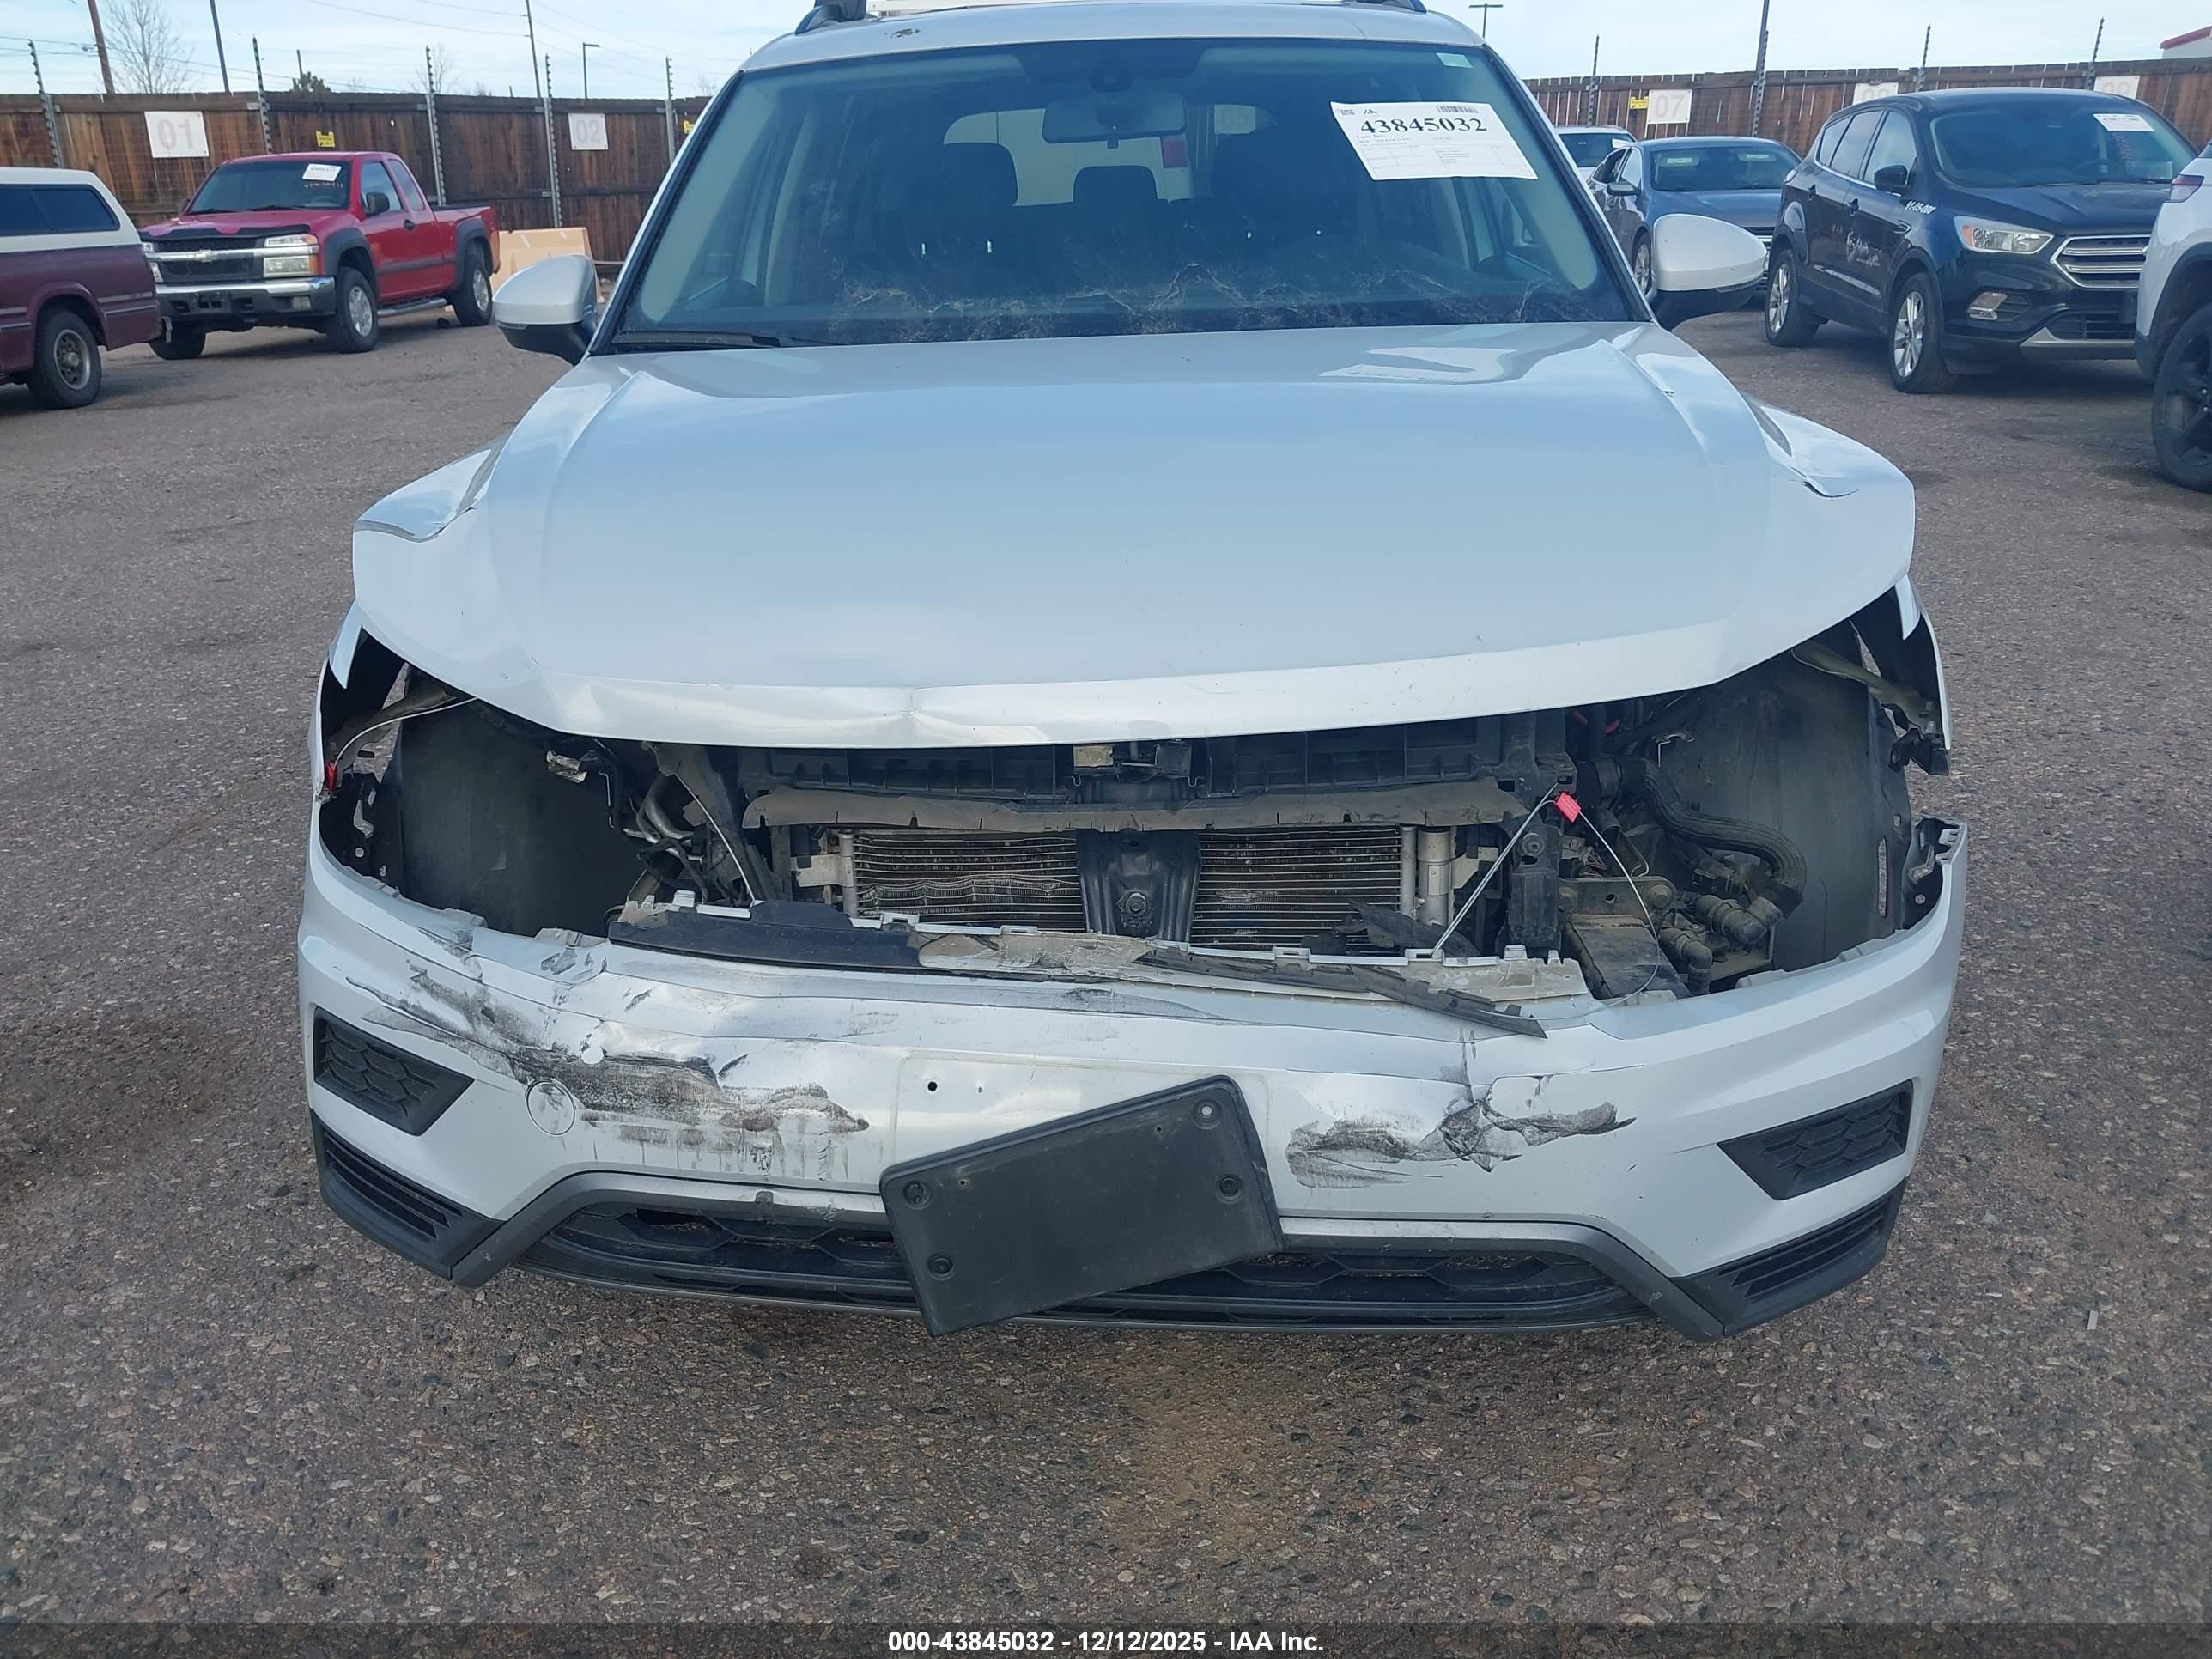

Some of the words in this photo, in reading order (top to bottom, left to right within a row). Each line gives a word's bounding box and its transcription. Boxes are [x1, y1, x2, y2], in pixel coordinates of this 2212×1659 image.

[1655, 94, 1685, 118] 07
[157, 118, 194, 149] 01
[576, 119, 602, 144] 02
[1361, 118, 1487, 133] 43845032
